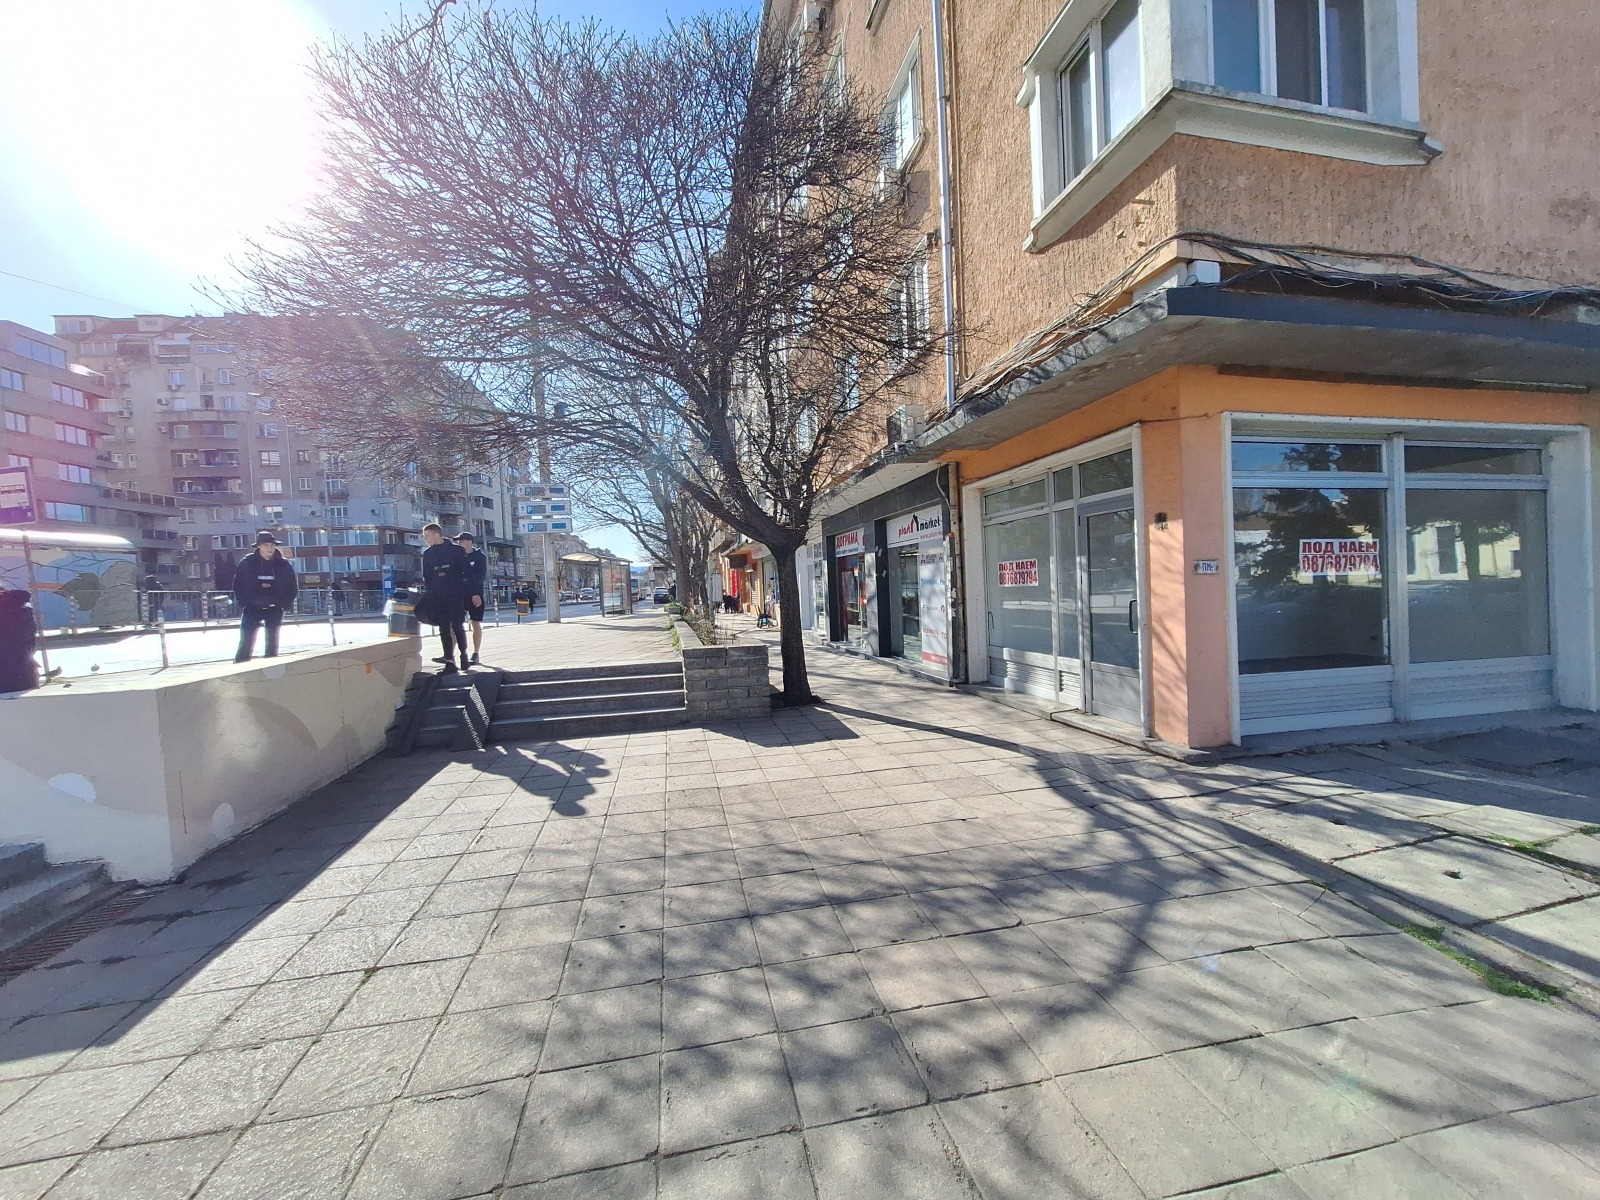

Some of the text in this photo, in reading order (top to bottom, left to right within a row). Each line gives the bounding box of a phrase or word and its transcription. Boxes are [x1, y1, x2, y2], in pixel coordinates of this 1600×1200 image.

[920, 516, 941, 531] market
[1302, 541, 1378, 554] ПОД НАЕМ
[998, 560, 1037, 572] ПОД НАЕМ
